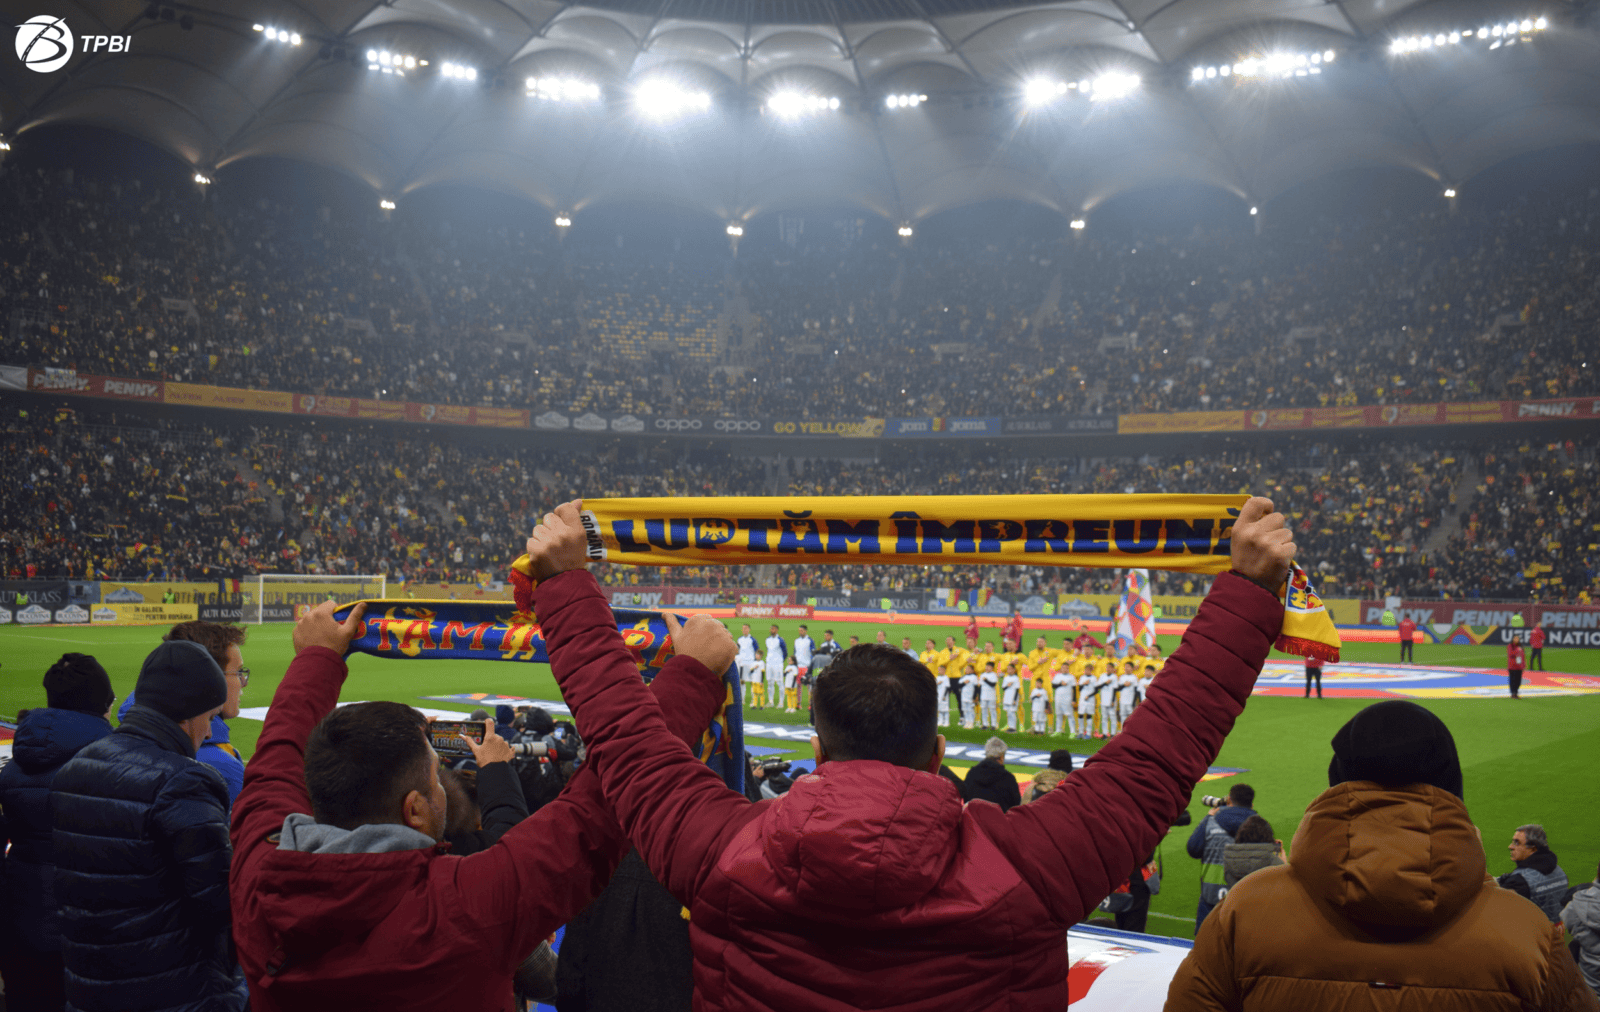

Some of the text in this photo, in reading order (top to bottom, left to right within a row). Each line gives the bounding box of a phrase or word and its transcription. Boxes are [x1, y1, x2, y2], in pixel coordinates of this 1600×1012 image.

[104, 379, 158, 397] PENNY
[655, 419, 702, 431] oppo
[713, 420, 760, 432] oppo
[773, 422, 796, 434] GO
[899, 422, 927, 433] Jom
[612, 510, 881, 553] LUPTĂM
[612, 592, 663, 606] PENY
[675, 592, 720, 606] PENN
[740, 593, 788, 606] ENNY
[741, 606, 774, 616] PENNY
[779, 607, 808, 616] PENNY
[1540, 611, 1600, 628] PENN
